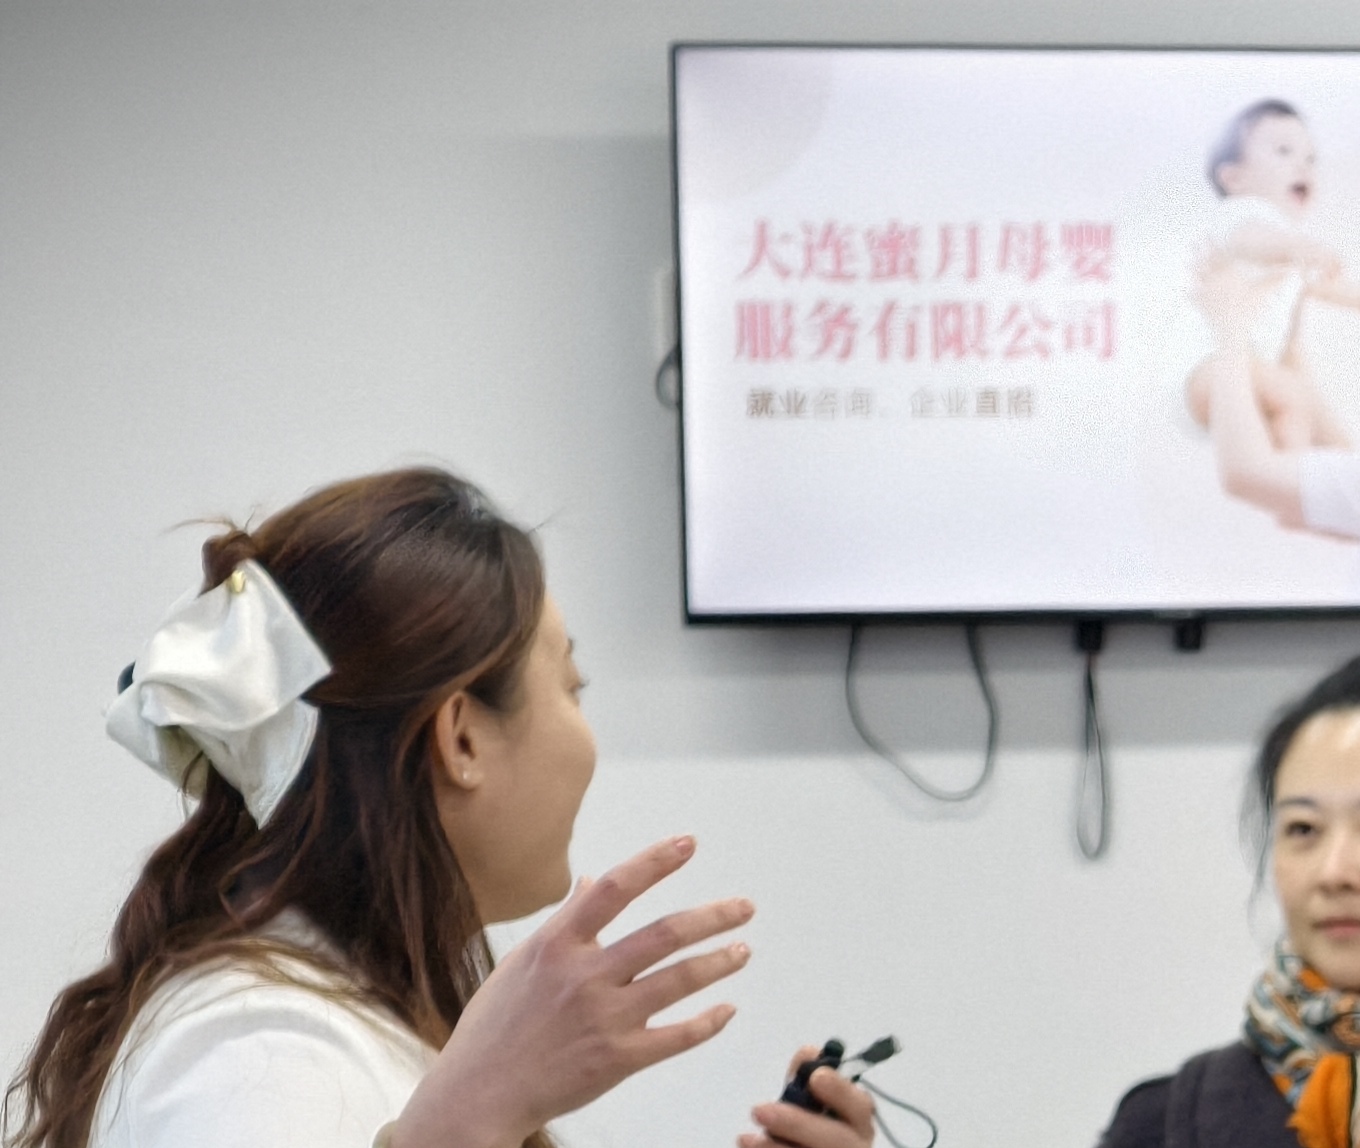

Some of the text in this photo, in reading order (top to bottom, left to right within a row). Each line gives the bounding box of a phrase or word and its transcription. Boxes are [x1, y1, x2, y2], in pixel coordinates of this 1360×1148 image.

[736, 218, 1115, 284] 大连蜜月母婴
[734, 297, 1118, 363] 服务有限公司
